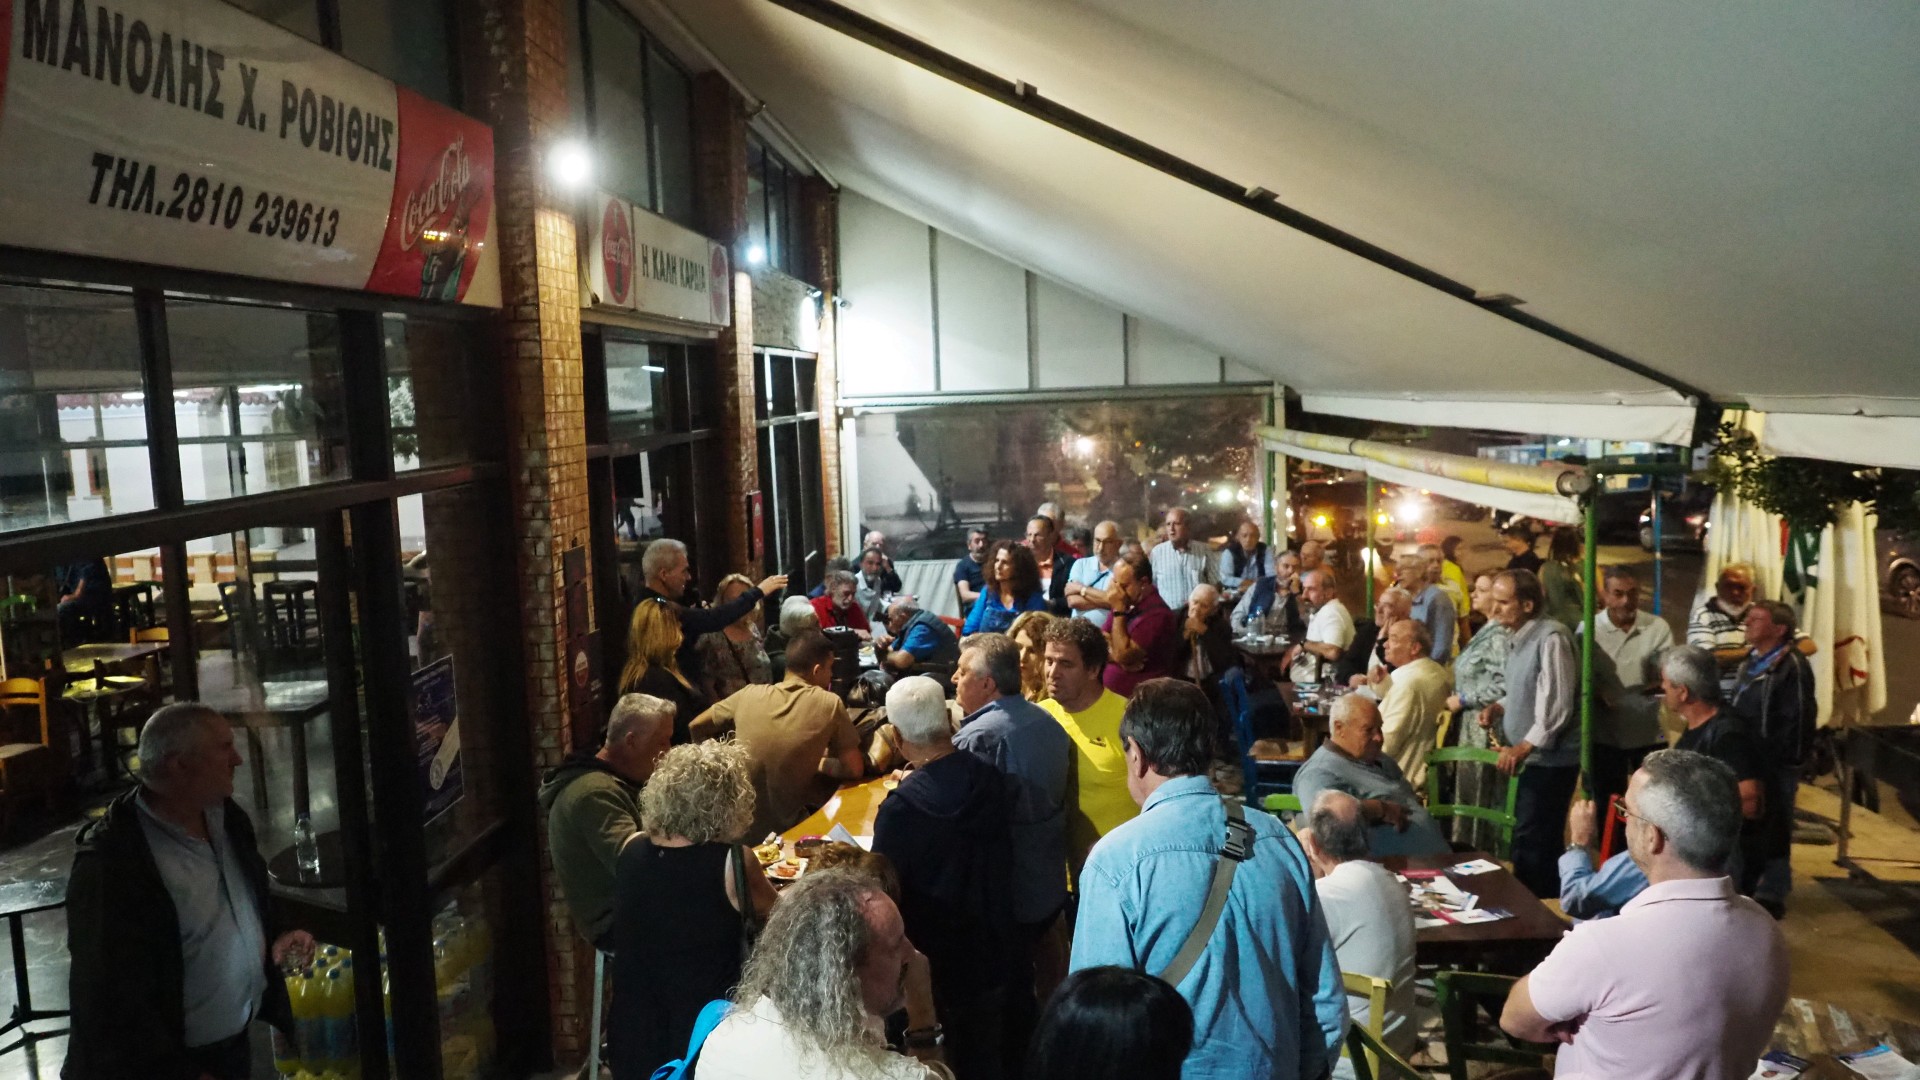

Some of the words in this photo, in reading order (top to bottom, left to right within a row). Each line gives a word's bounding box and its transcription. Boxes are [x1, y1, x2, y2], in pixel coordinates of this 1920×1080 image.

[22, 0, 225, 119] ΜΑΝΟΛΗΣ
[280, 80, 394, 172] ΡΟΒΙΘΗΣ
[248, 192, 340, 247] 239613
[641, 243, 649, 278] Η
